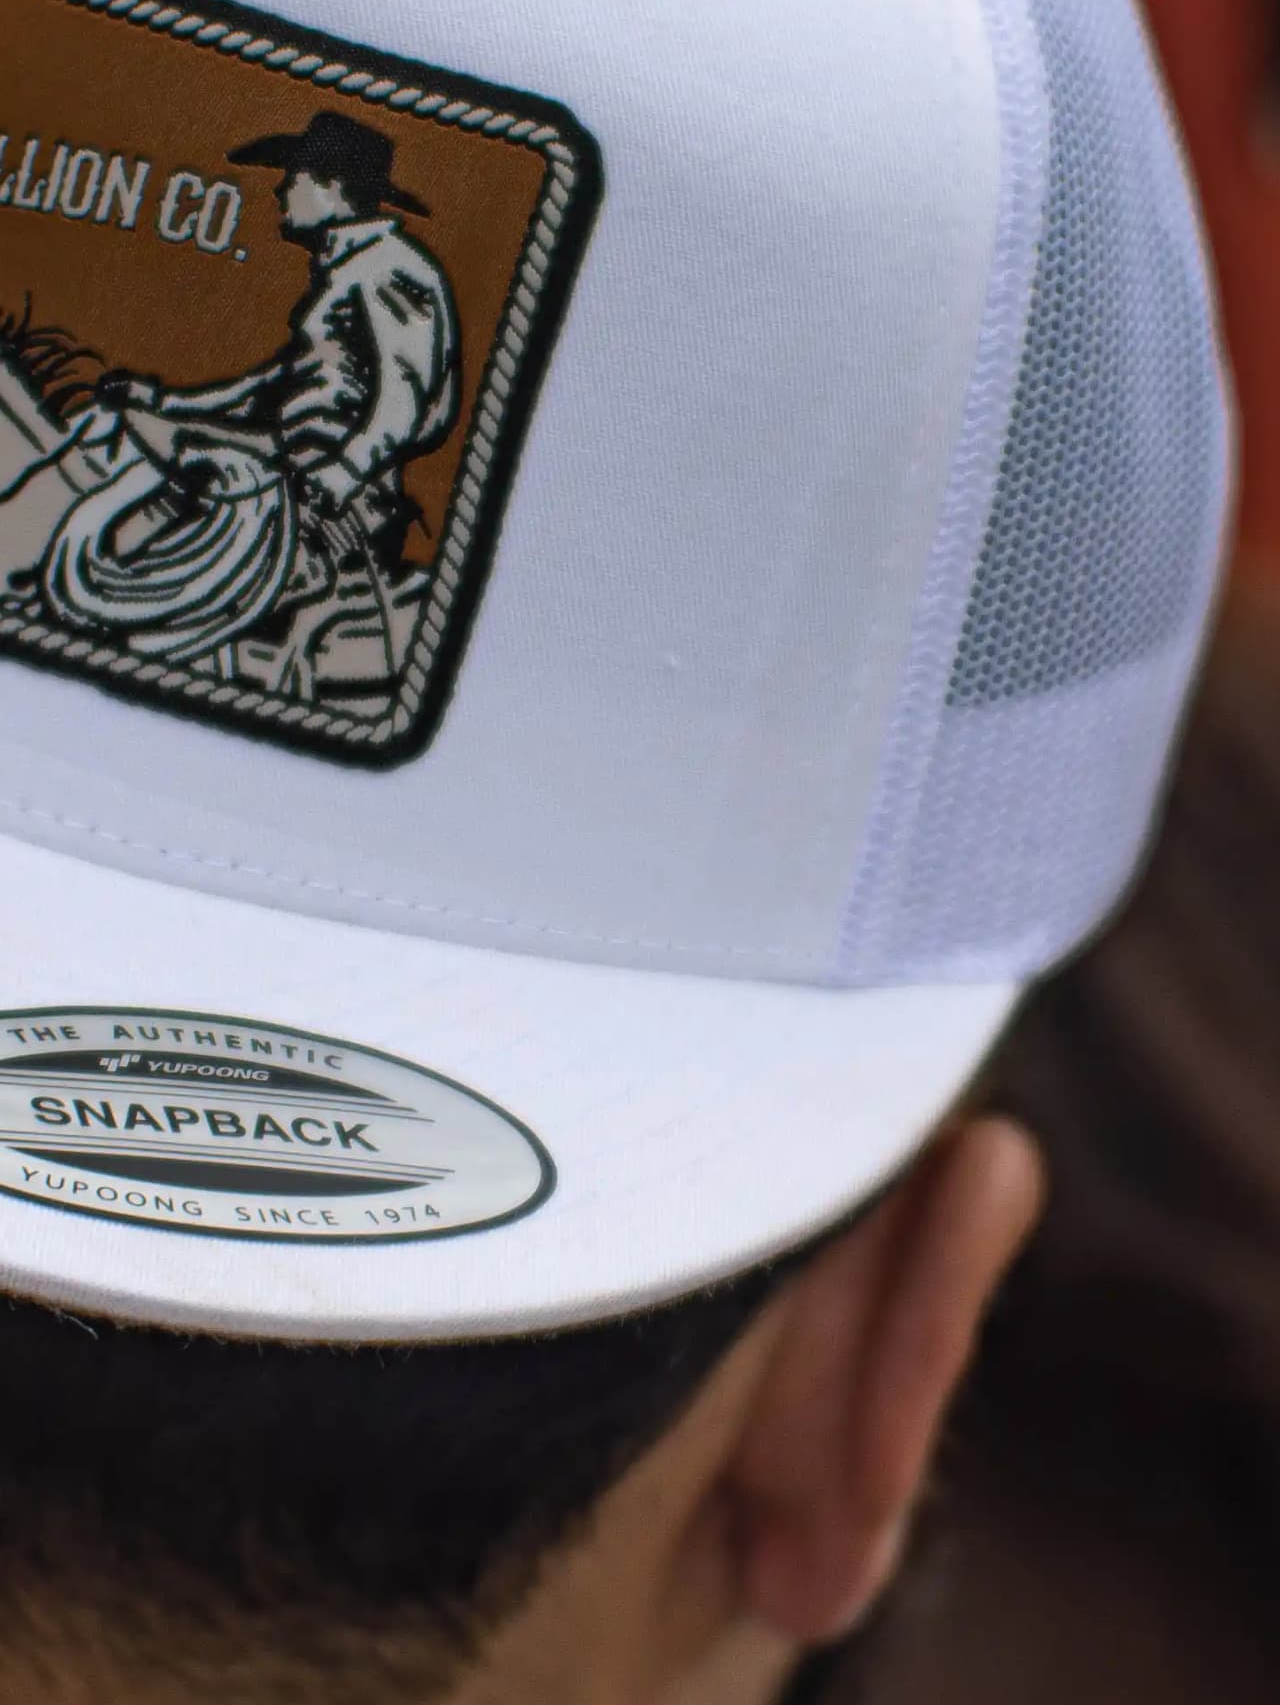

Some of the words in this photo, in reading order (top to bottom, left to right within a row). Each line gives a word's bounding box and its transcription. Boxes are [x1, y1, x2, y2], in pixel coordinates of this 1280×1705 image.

[158, 170, 248, 262] CO.
[6, 1025, 81, 1044] THE
[112, 1024, 343, 1071] AUTHENTIC
[147, 1060, 270, 1082] YUPOONG
[29, 1095, 382, 1152] SNAPBACK
[21, 1164, 205, 1217] YUPOONG
[234, 1204, 340, 1227] SINCE
[364, 1202, 442, 1227] 1974
